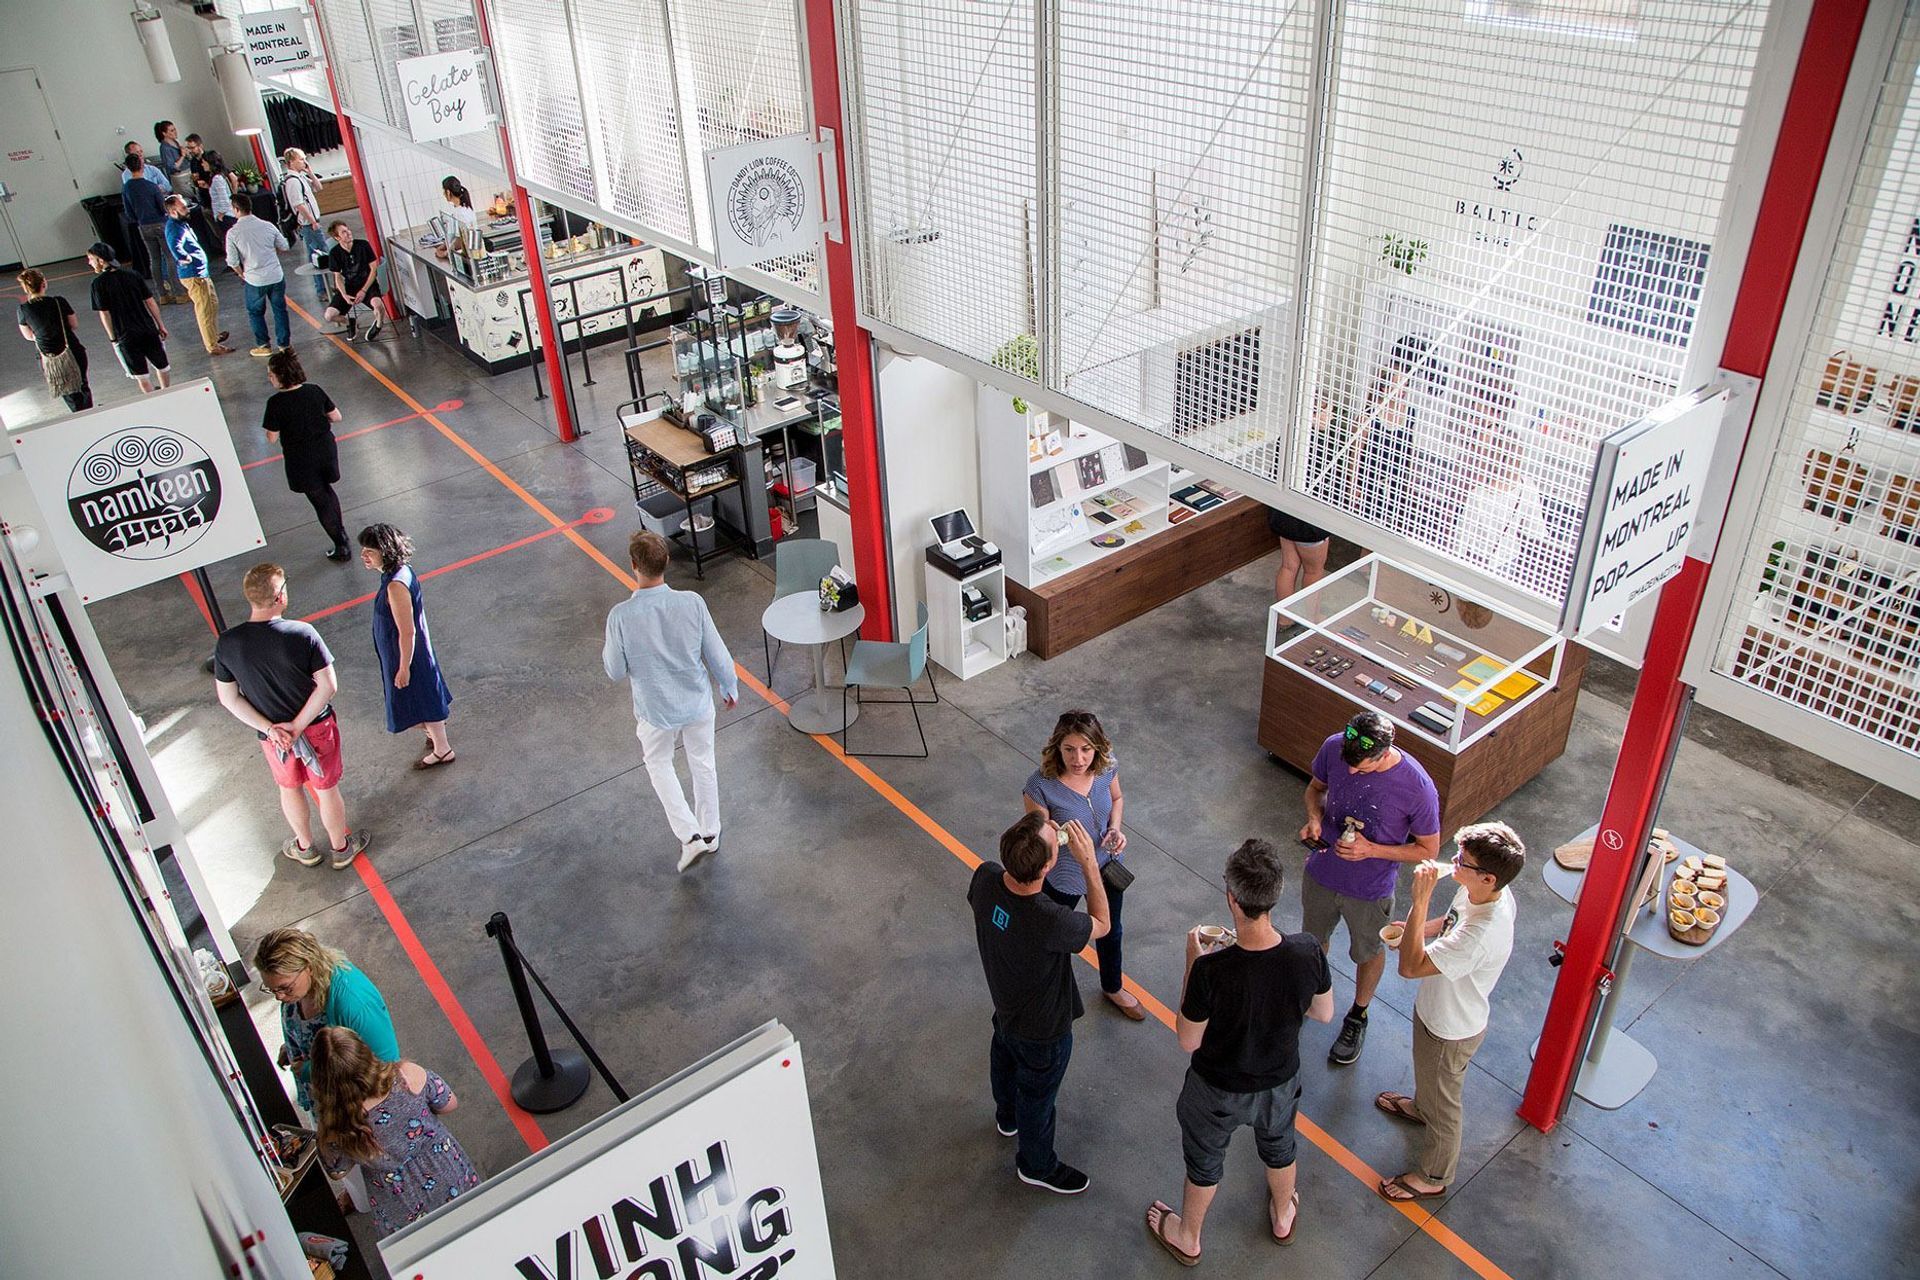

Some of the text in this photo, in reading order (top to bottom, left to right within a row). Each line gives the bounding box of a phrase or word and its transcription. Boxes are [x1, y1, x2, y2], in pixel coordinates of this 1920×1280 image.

[245, 23, 286, 36] MADE IN
[249, 36, 302, 51] MONTREAL
[407, 65, 473, 105] Gelato
[427, 98, 466, 124] Boy
[732, 165, 750, 188] DANDY
[749, 158, 764, 170] LION
[765, 157, 788, 170] COFFEE
[1456, 200, 1538, 231] BALTIC
[80, 468, 212, 528] namkeen
[1611, 449, 1685, 511] MADE IN
[103, 496, 206, 552] नमकीन
[1601, 484, 1691, 558] MONTREAL
[514, 1139, 738, 1280] VINH
